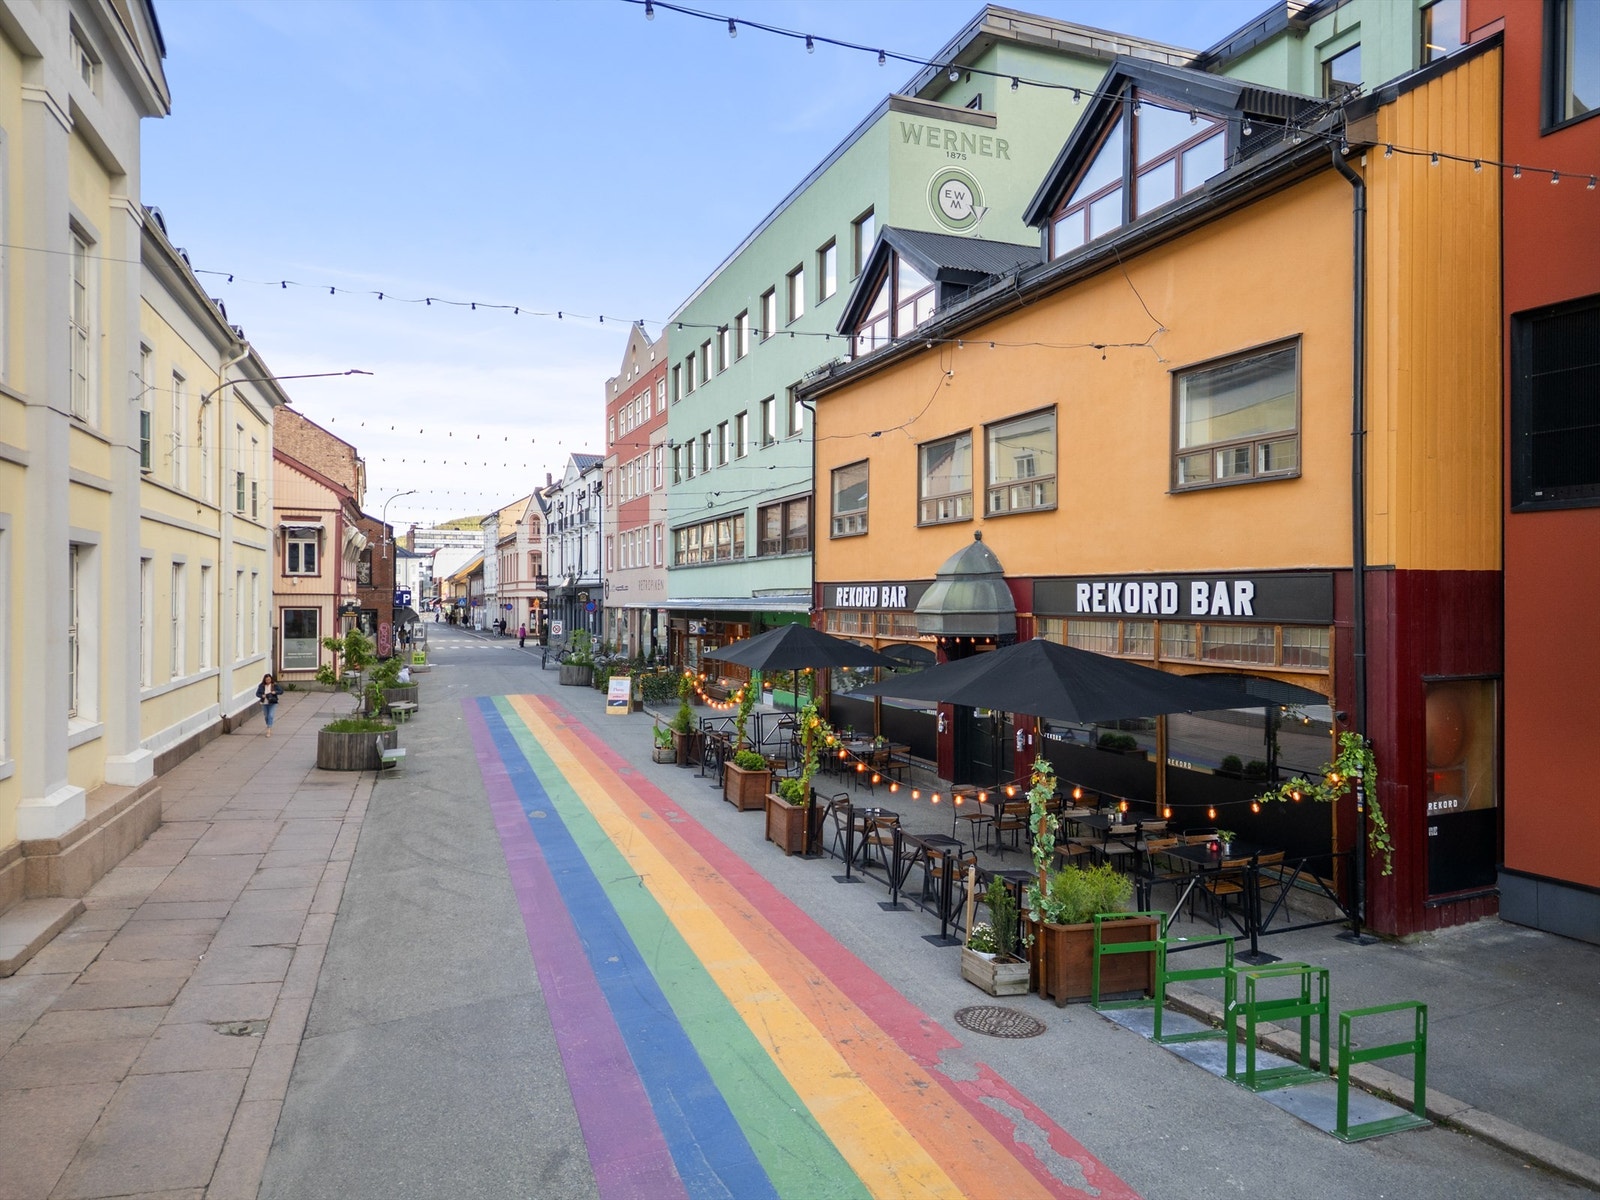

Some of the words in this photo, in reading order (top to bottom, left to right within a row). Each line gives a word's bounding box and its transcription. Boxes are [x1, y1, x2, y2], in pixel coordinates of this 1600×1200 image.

[900, 121, 1011, 160] WERNER
[946, 151, 967, 160] 1875
[403, 594, 411, 603] P
[835, 586, 878, 607] REKORD
[881, 585, 907, 608] BAR
[1076, 581, 1179, 615] REKORD
[1190, 580, 1256, 616] BAR
[1167, 758, 1192, 769] REKORD
[1427, 799, 1458, 810] REKORD
